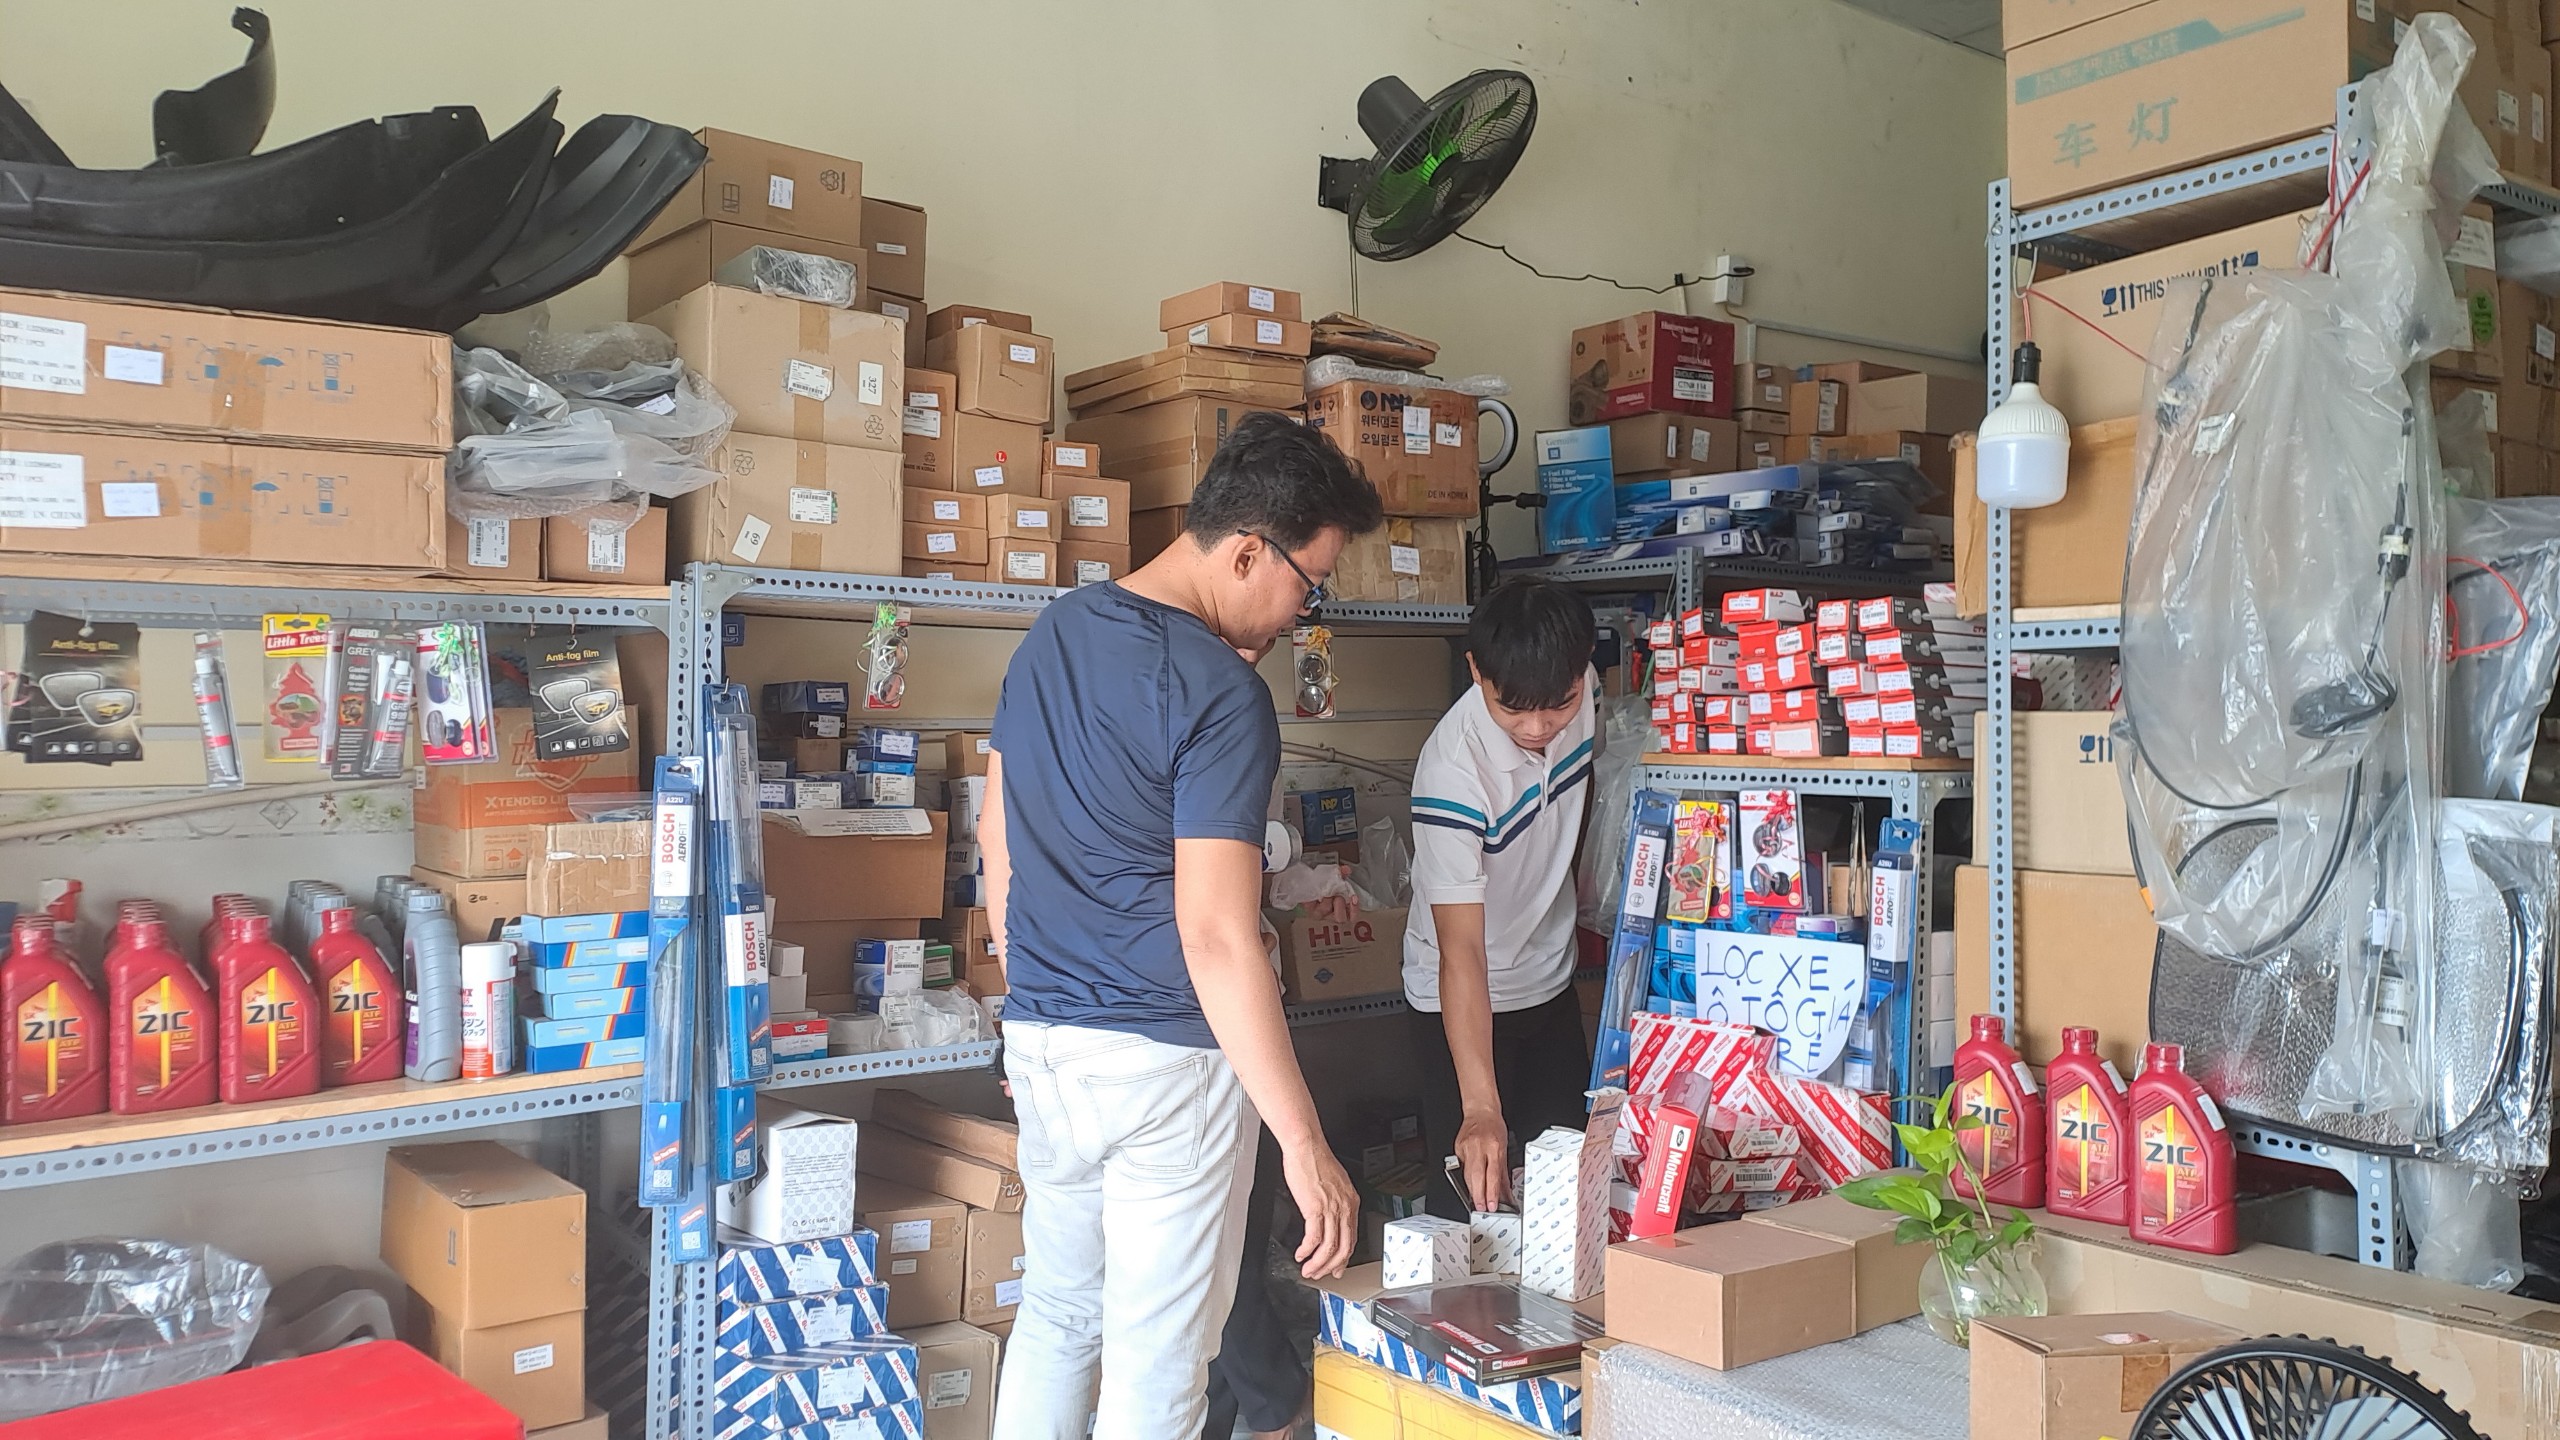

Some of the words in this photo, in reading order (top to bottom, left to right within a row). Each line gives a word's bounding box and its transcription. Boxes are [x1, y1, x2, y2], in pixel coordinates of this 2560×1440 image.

[2135, 279, 2165, 302] THIS
[868, 376, 877, 394] 327
[267, 635, 295, 648] Little
[299, 633, 328, 646] Trees
[349, 628, 379, 638] ABRO
[51, 640, 97, 652] Anti-fog
[98, 640, 120, 650] film
[347, 647, 376, 656] GREY
[546, 651, 582, 663] Anti-fog
[583, 649, 600, 659] film
[391, 702, 408, 711] GRE
[485, 795, 547, 809] XTENDED
[661, 813, 675, 863] BOSCH
[677, 822, 687, 862] AEROFIT
[1633, 843, 1650, 887] BOSCH
[1647, 852, 1660, 888] AEROFIT
[1874, 875, 1885, 926] BOSCH
[1886, 886, 1895, 928] AEROFIT
[744, 921, 757, 971] BOSCH
[1308, 921, 1375, 948] Hi-Q
[757, 929, 766, 968] AEROFIT
[1777, 952, 1829, 991] XE
[246, 1001, 298, 1025] ZIC
[333, 990, 381, 1013] ZIC
[24, 1016, 82, 1043] ZIC
[137, 1010, 193, 1035] ZIC
[1966, 1103, 2011, 1127] ZIC
[2060, 1118, 2110, 1143] ZIC
[2144, 1141, 2199, 1167] ZIC
[1655, 1150, 1683, 1214] Motorcraft
[749, 1265, 766, 1290] BOSCH
[762, 1317, 778, 1341] BOSCH
[893, 1358, 909, 1383] BOSCH
[1530, 1378, 1543, 1410] BOSCH
[898, 1410, 914, 1434] BOSCH
